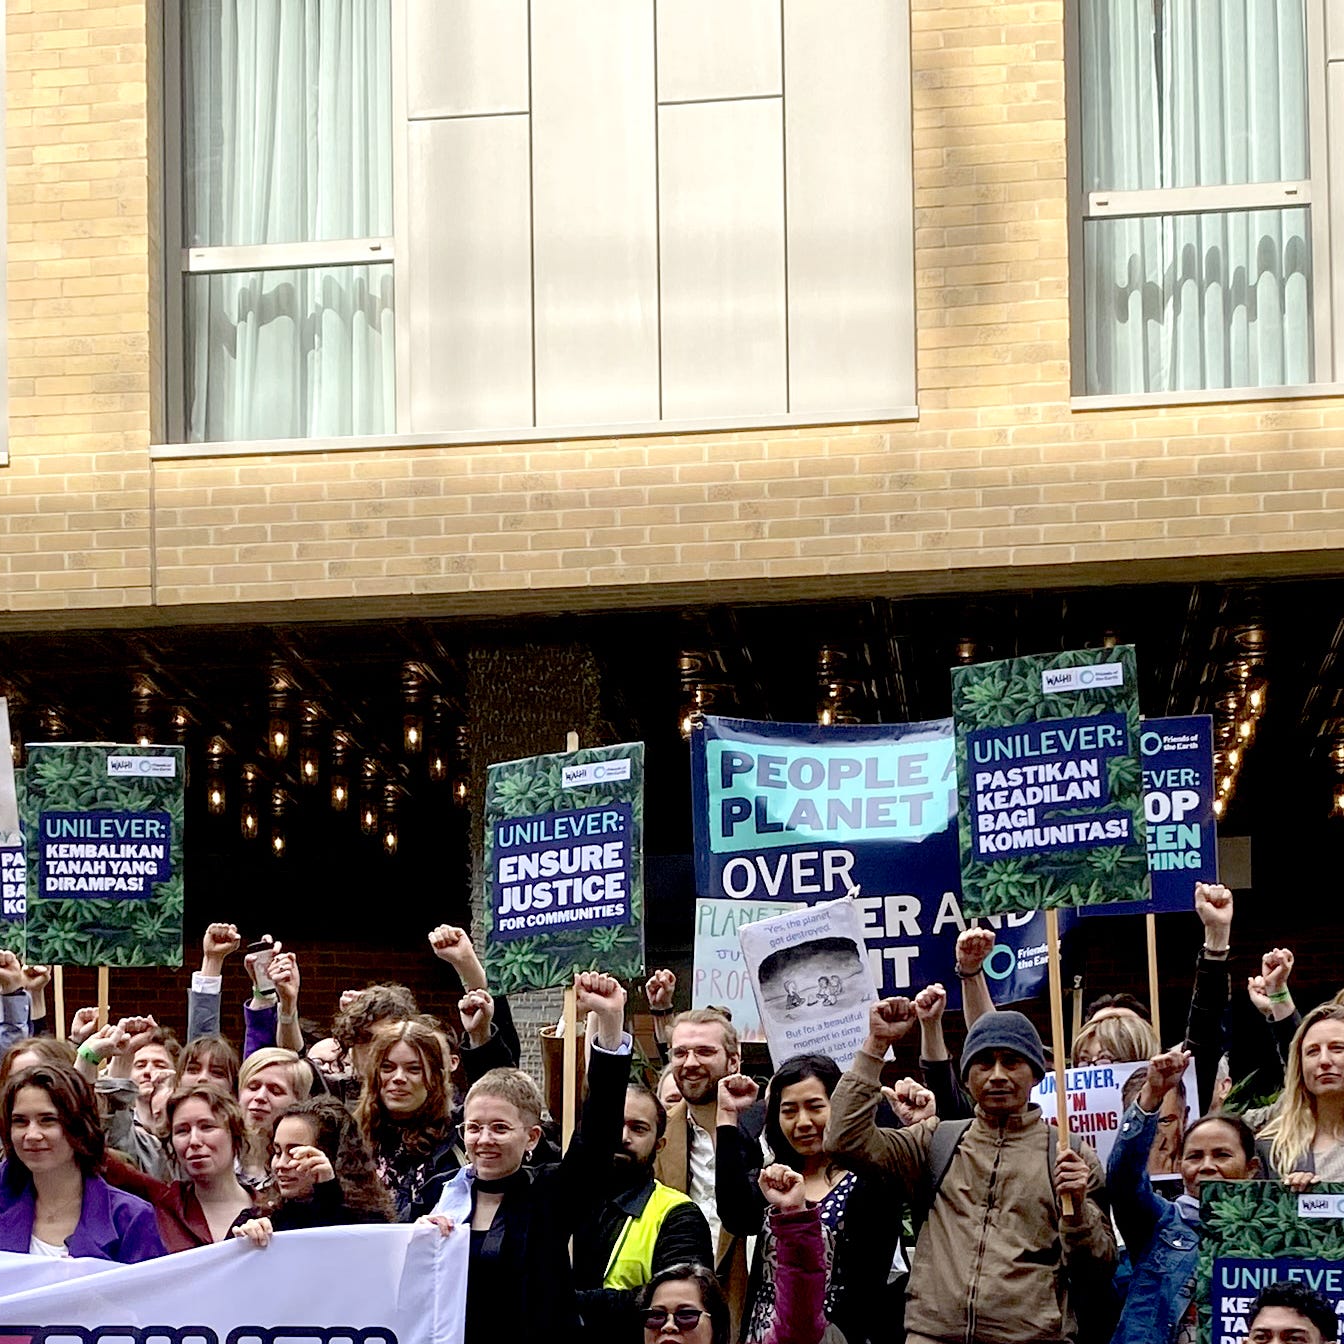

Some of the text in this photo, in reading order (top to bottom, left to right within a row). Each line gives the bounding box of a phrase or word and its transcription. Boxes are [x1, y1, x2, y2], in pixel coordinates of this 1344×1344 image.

[973, 724, 1123, 764] UNILEVER:
[1162, 734, 1199, 744] Friends of
[1162, 741, 1199, 751] the Earth
[720, 750, 929, 791] PEOPLE
[975, 758, 1099, 791] PASTIKAN
[976, 779, 1101, 812] KEADILAN
[1144, 790, 1200, 822] OP
[45, 819, 166, 838] UNILEVER:
[721, 792, 935, 837] PLANET
[977, 809, 1035, 832] BAGI
[497, 811, 625, 848] UNILEVER:
[979, 819, 1129, 854] KOMUNITAS!
[1147, 823, 1201, 852] EEN
[45, 844, 164, 860] KEMBALIKAN
[498, 841, 624, 884] ENSURE
[45, 861, 158, 876] TANAH YANG
[722, 850, 855, 899] OVER
[45, 877, 144, 892] DIRAMPAS!
[498, 872, 626, 915] JUSTICE
[499, 904, 625, 931] FOR COMMUNITIES
[786, 910, 831, 928] the planet
[1017, 957, 1033, 970] the
[785, 1011, 863, 1039] But for a beautiful
[793, 1025, 862, 1049] moment in time
[1039, 1068, 1120, 1095] UNLEVER,
